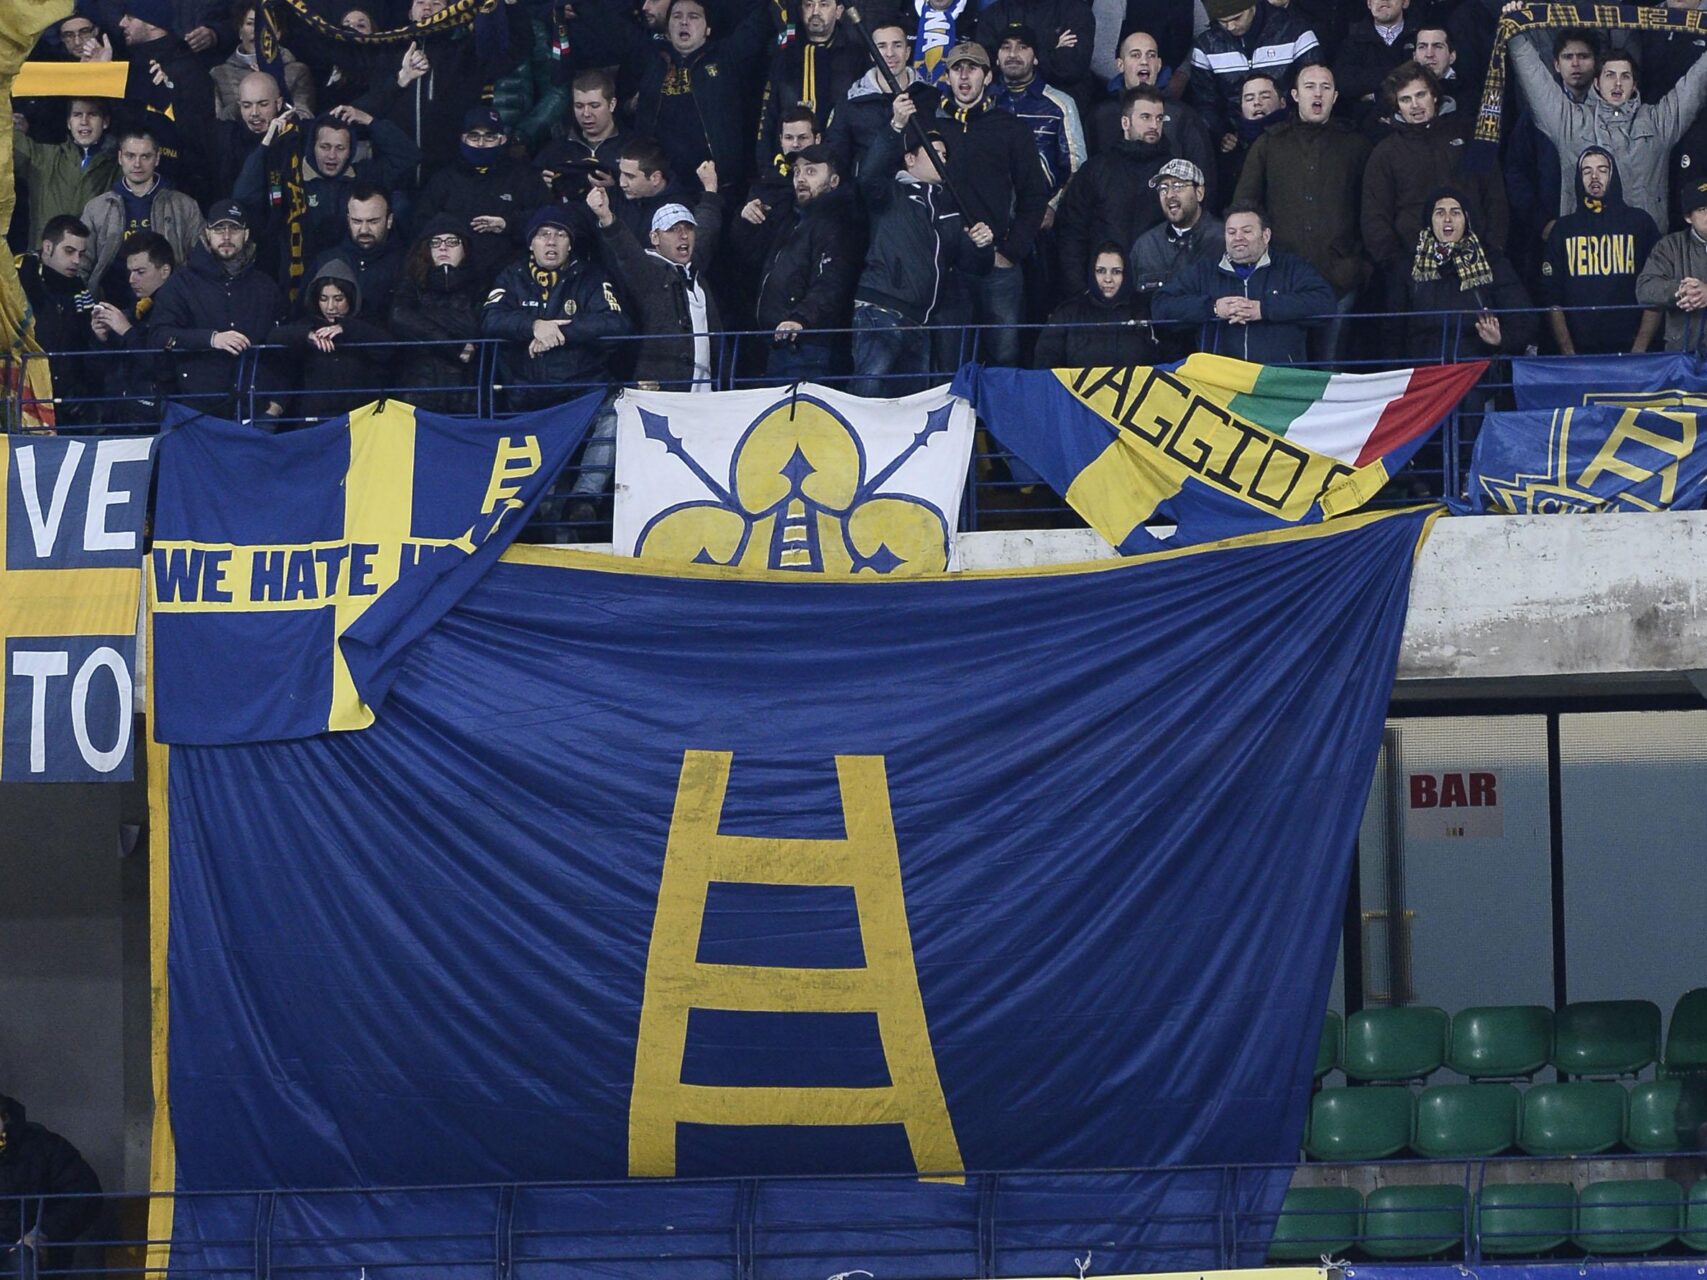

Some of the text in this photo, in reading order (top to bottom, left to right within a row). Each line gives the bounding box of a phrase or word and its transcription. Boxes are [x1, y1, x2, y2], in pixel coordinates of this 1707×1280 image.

[1565, 234, 1636, 277] VERONA
[15, 436, 155, 559] VE
[153, 547, 233, 603] WE
[250, 543, 380, 603] HATE
[11, 645, 134, 775] TO
[1409, 772, 1498, 810] BAR
